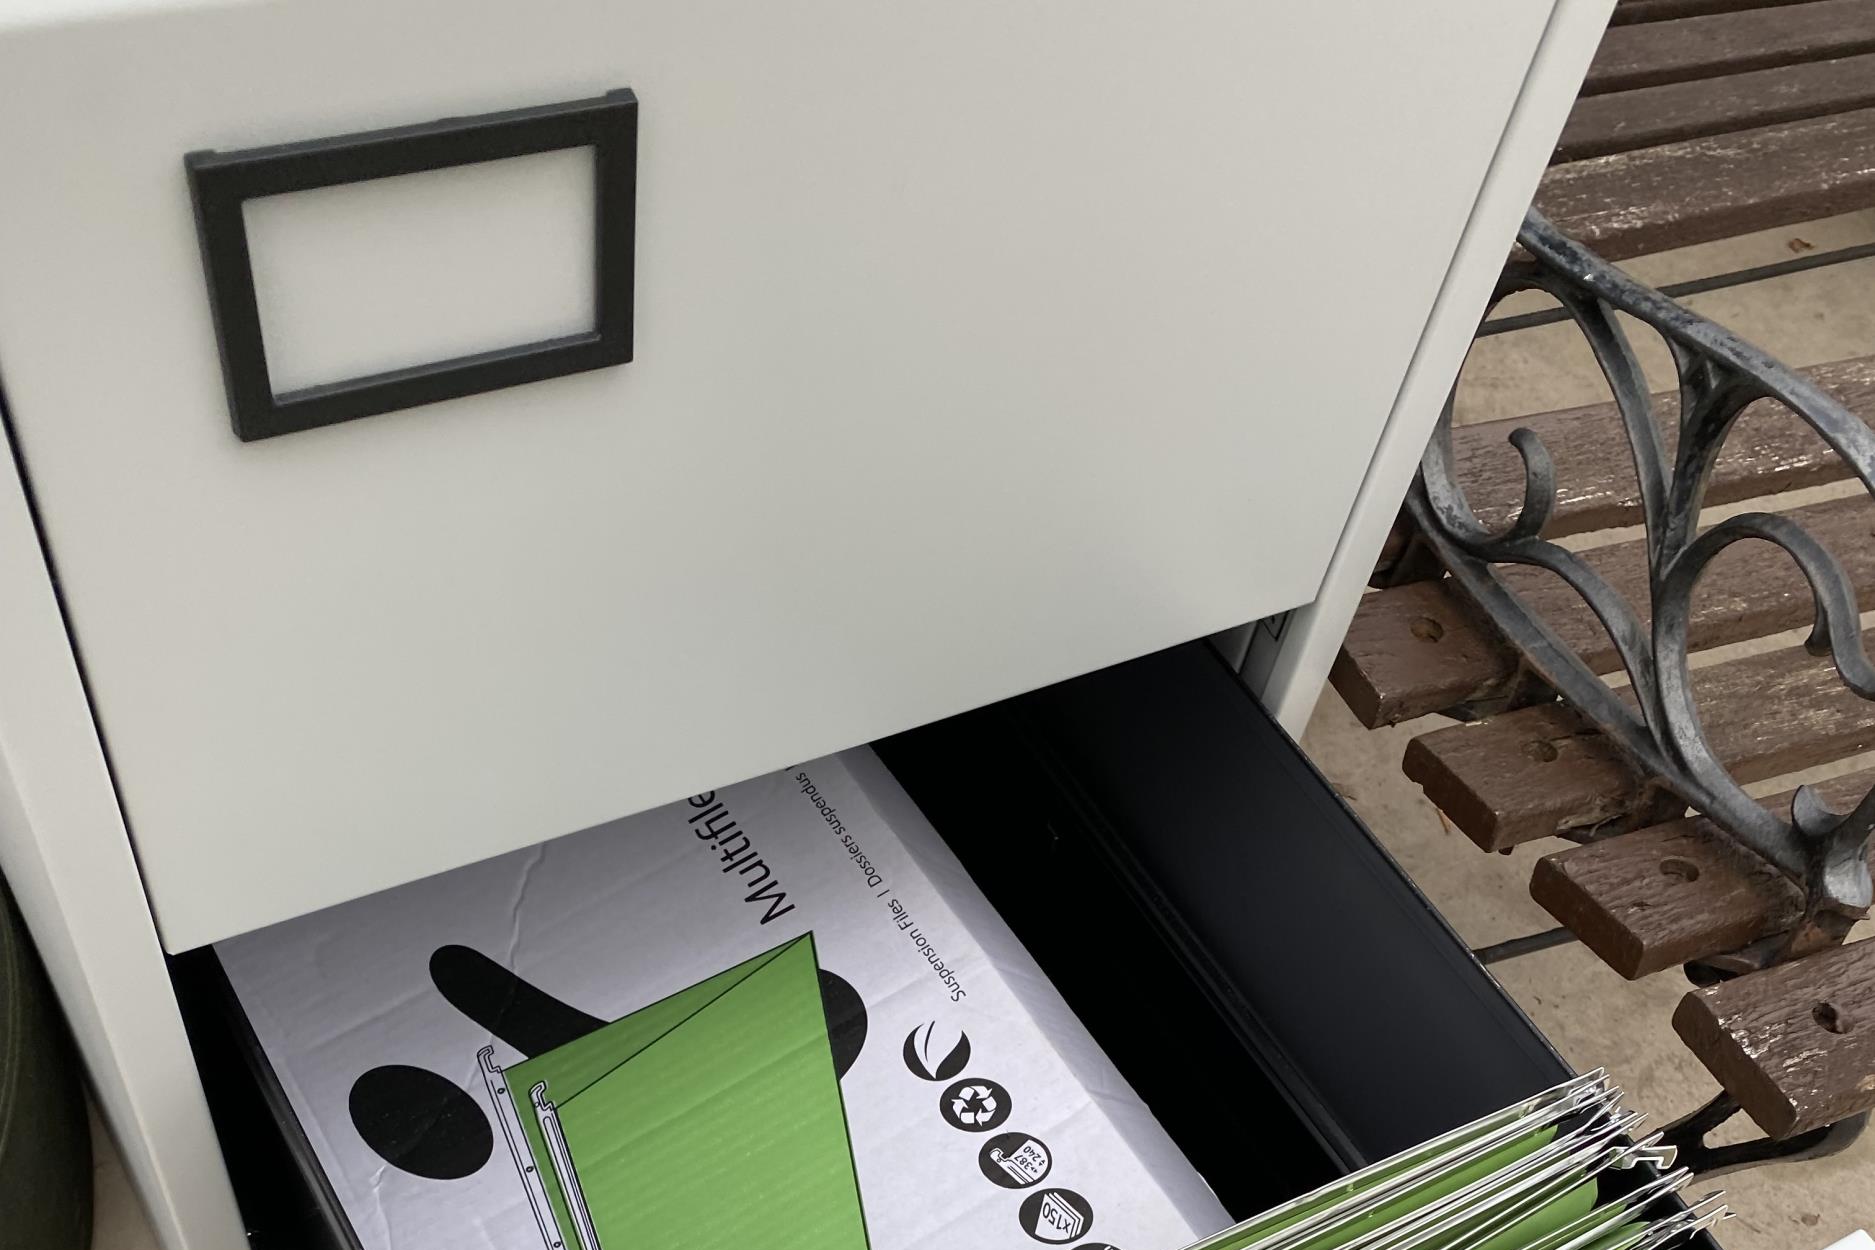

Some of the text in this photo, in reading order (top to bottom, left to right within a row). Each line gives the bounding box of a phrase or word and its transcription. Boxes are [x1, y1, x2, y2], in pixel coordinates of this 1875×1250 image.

[796, 772, 846, 836] suspendus
[688, 790, 796, 926] Multifile
[841, 834, 883, 888] Dossiers
[887, 898, 914, 931] Files
[910, 928, 967, 1002] Suspension
[1014, 1154, 1031, 1170] 387
[1023, 1145, 1040, 1161] 240
[1042, 1201, 1072, 1234] x150
